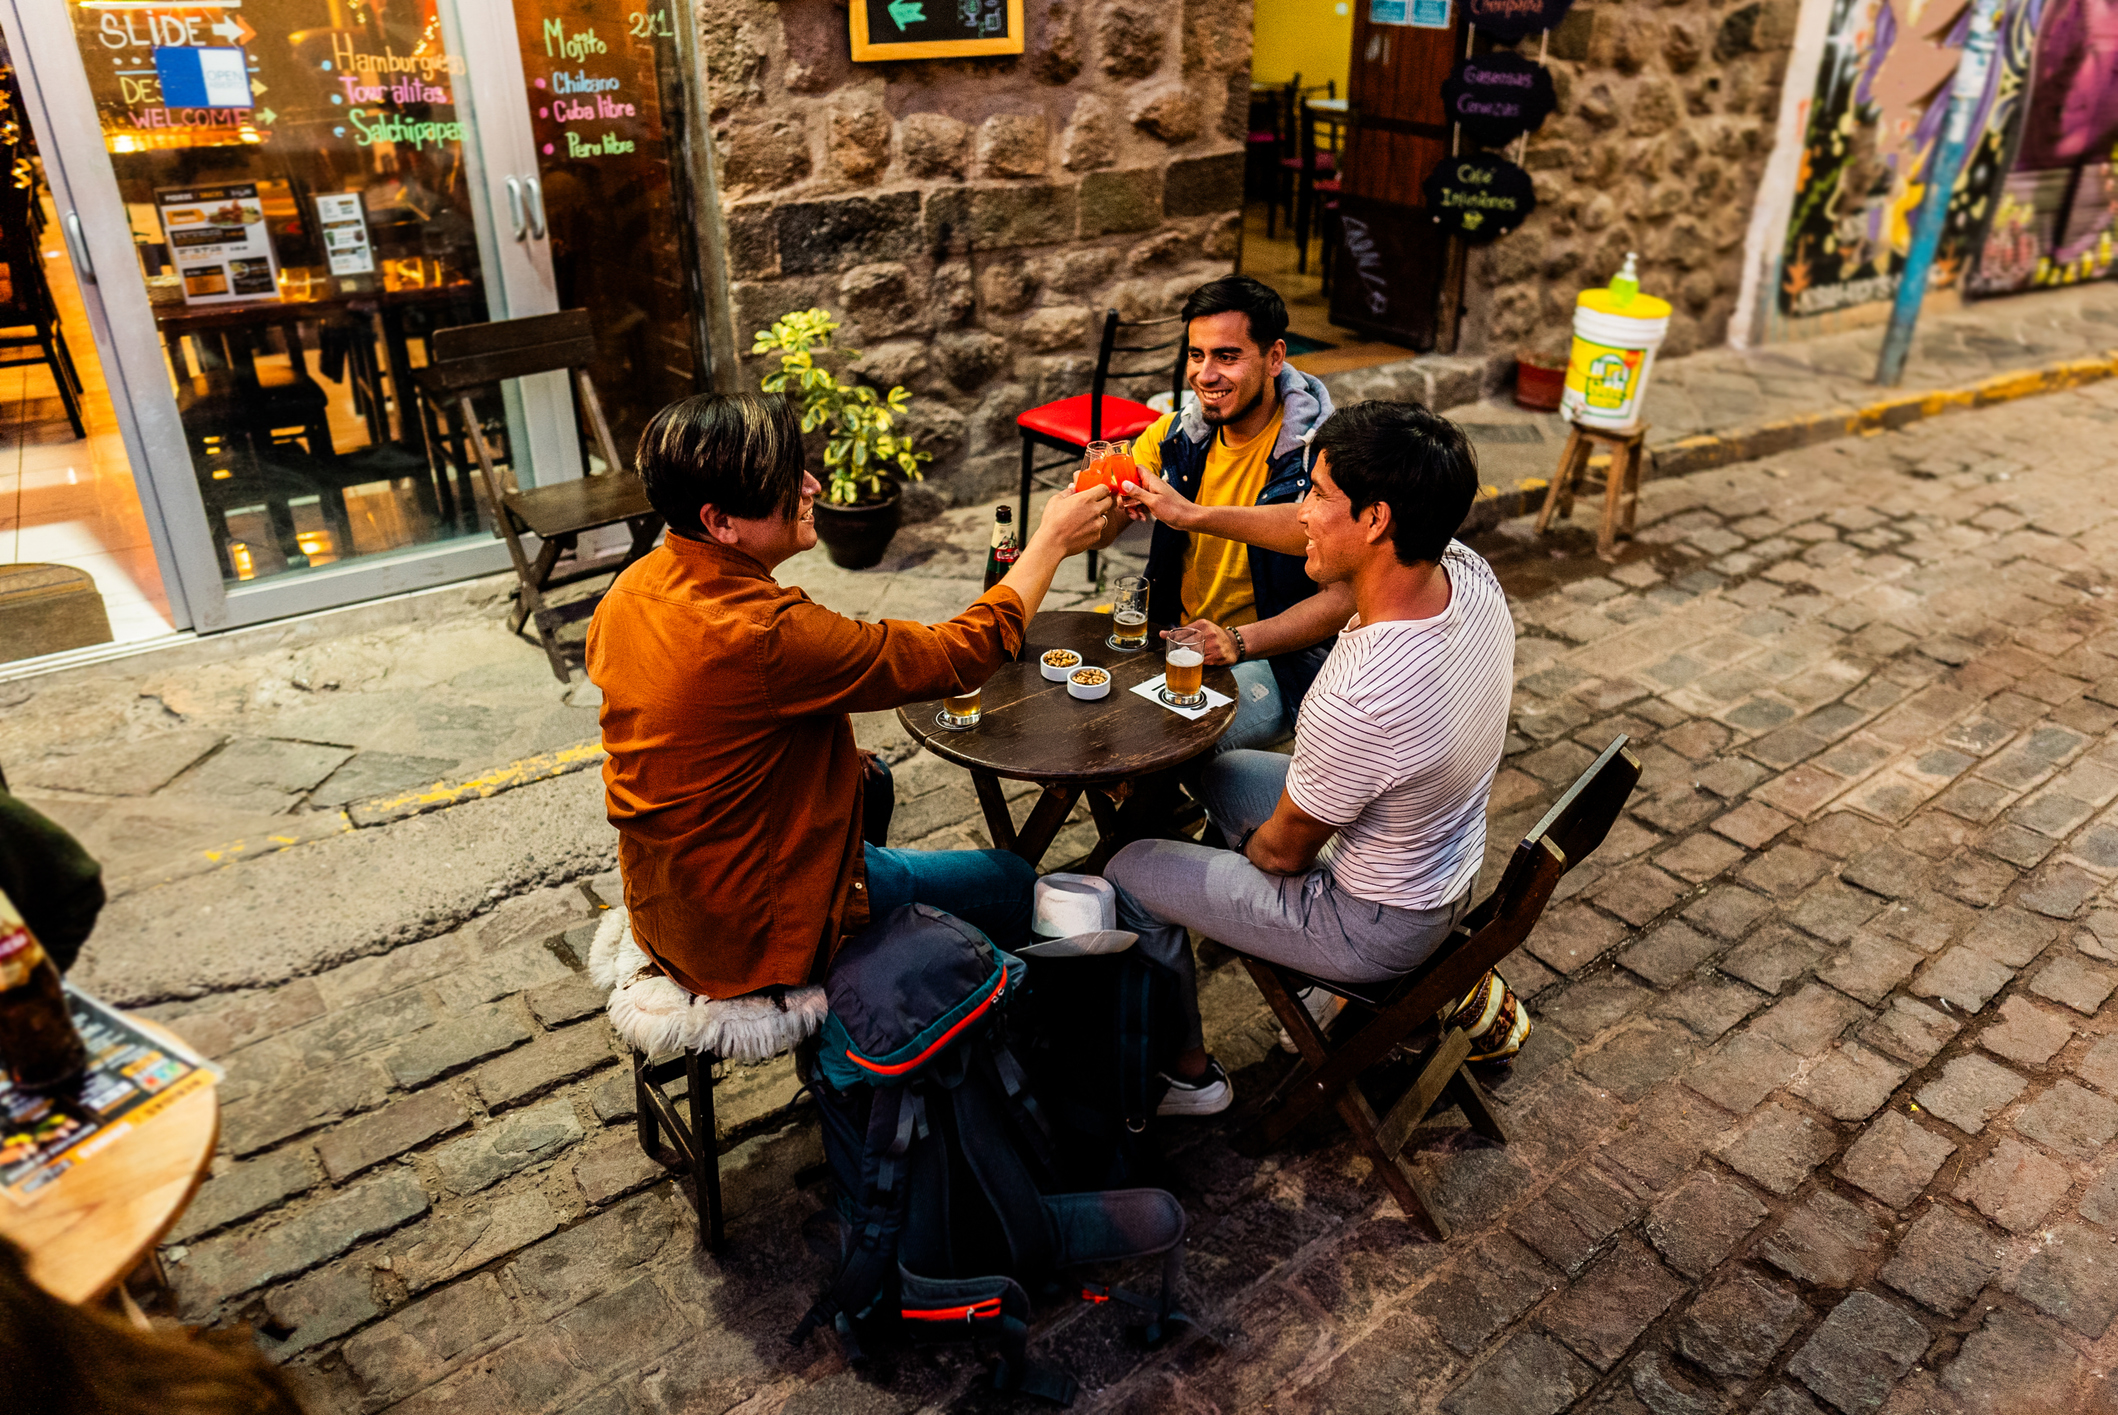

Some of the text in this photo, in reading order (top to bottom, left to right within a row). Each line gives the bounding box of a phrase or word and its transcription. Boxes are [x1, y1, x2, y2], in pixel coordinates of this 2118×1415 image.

[543, 17, 607, 63] Mojito
[129, 107, 253, 129] WELCOME
[553, 94, 636, 123] Cuba libre
[349, 109, 470, 151] Salchipapas
